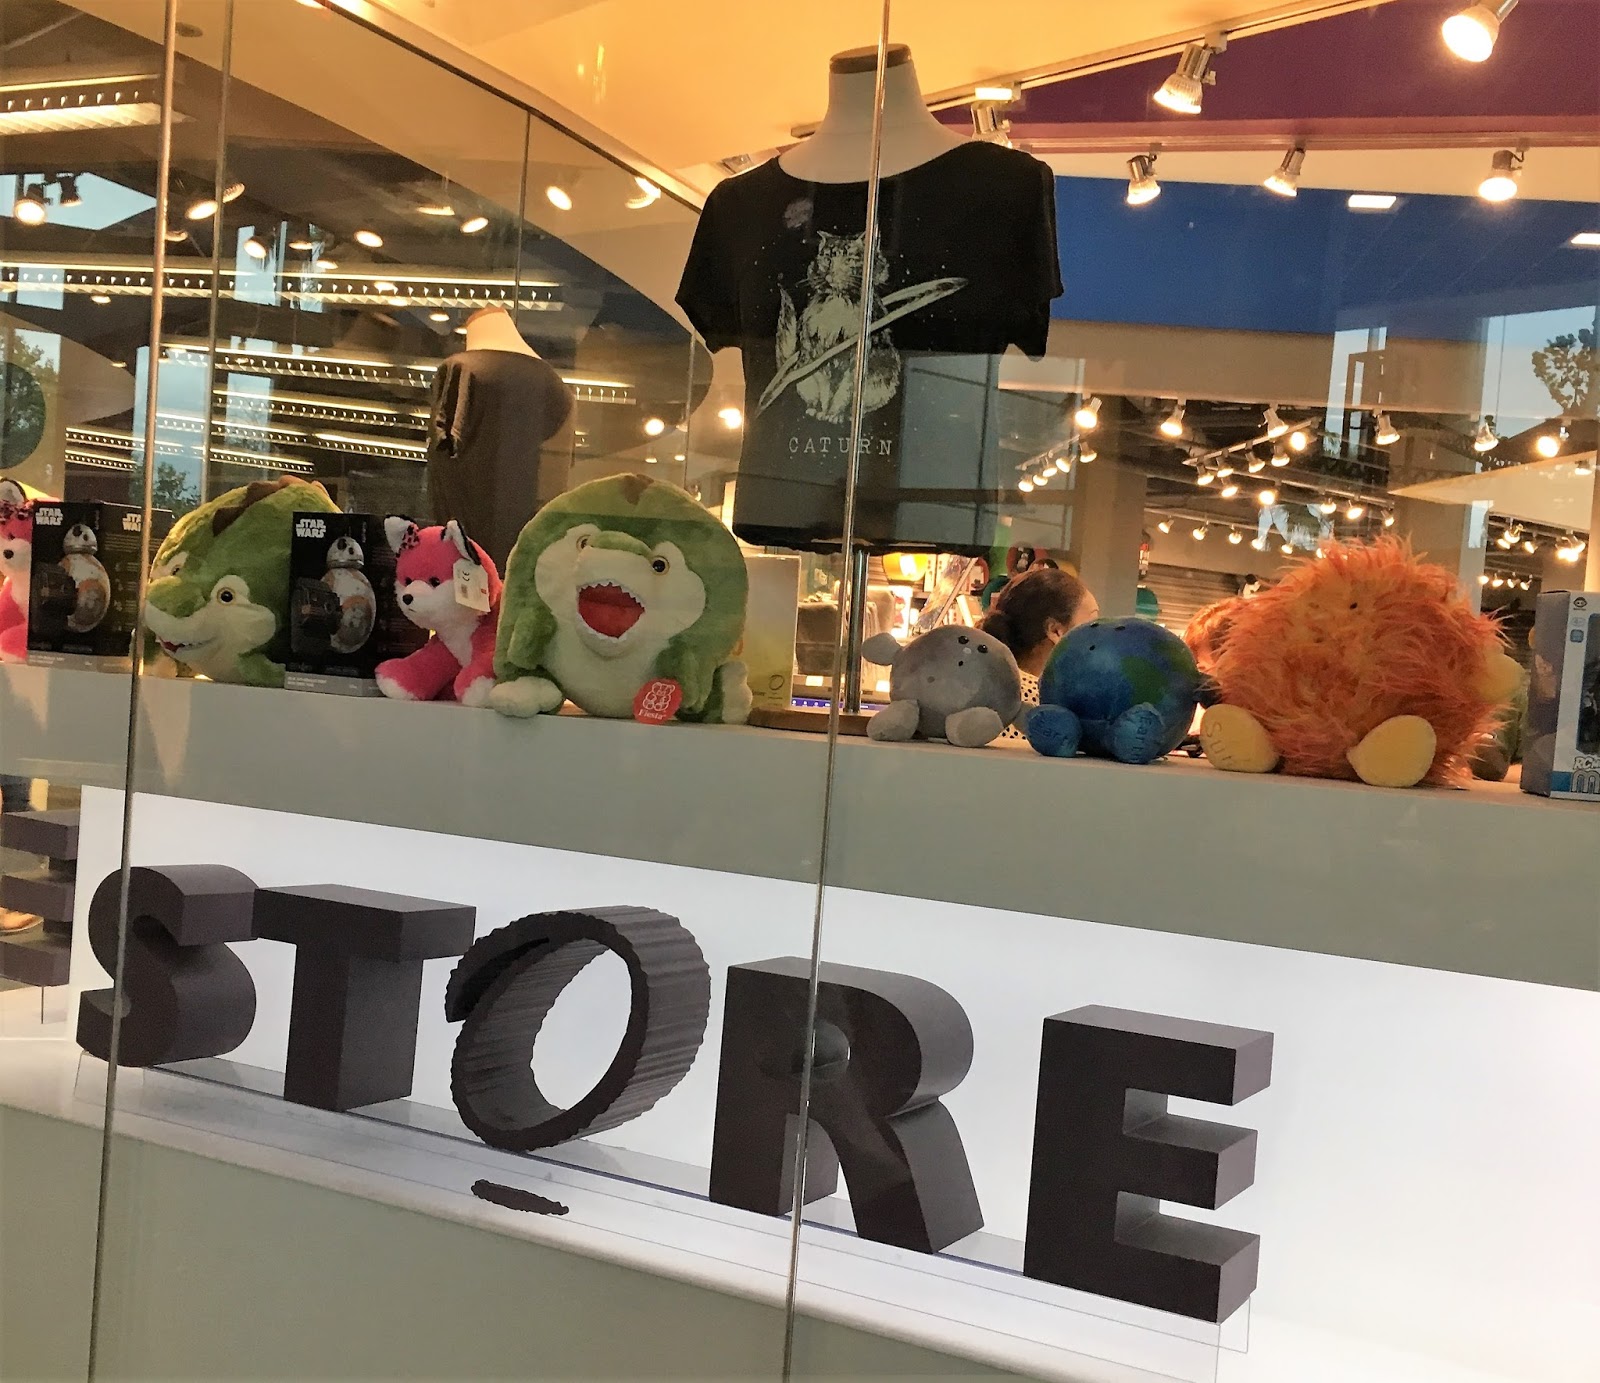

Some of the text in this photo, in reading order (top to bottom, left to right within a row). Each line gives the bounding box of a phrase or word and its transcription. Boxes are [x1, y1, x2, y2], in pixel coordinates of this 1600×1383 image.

[788, 436, 893, 456] CATURN
[35, 507, 63, 518] STAR
[35, 517, 63, 526] WARS
[296, 518, 326, 529] STAR
[295, 528, 326, 538] WARS
[76, 862, 1274, 1322] STORE
